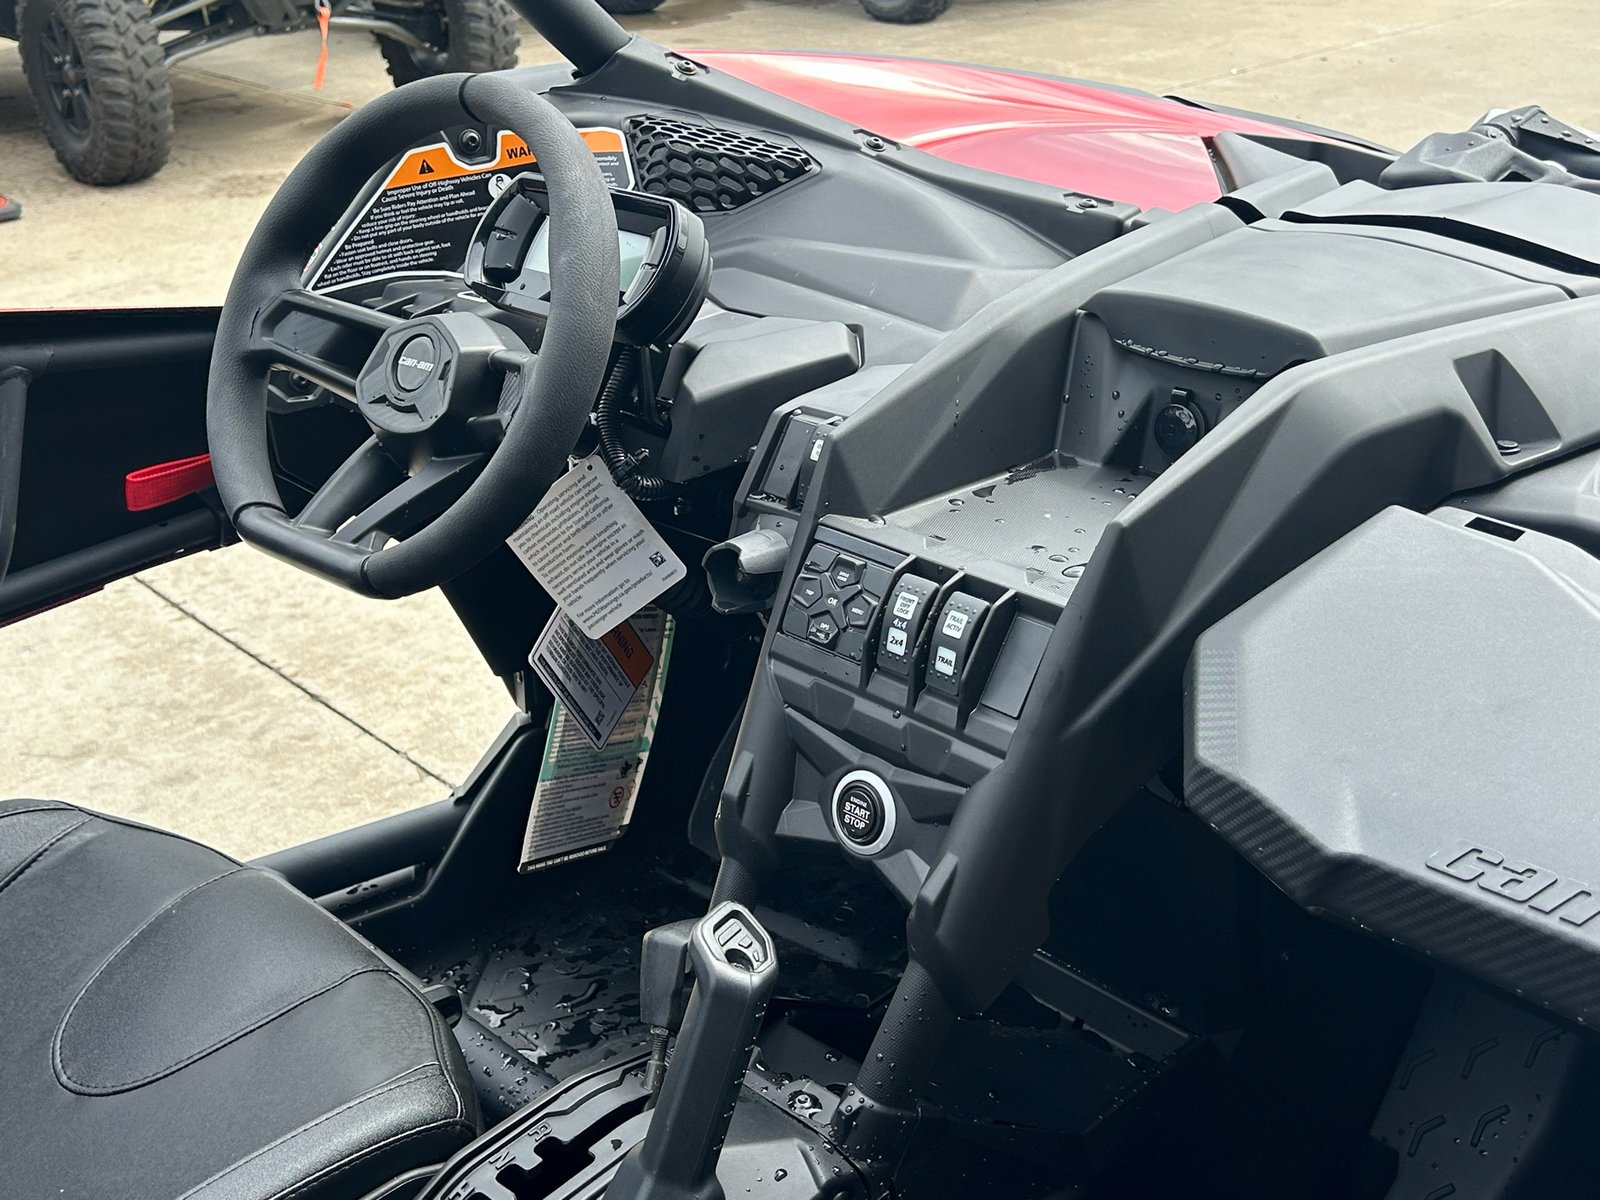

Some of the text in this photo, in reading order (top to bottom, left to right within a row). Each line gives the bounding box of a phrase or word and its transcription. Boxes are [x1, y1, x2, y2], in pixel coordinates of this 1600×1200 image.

[352, 239, 374, 248] Prepared
[398, 356, 433, 371] can-am
[827, 597, 839, 606] OK
[900, 596, 915, 604] FRONT
[851, 607, 865, 616] MENU
[896, 607, 909, 615] LOCK
[893, 618, 908, 630] 4x4
[949, 615, 964, 625] TRAIL
[819, 622, 830, 631] DPS
[945, 623, 962, 632] ACTIV
[890, 636, 904, 647] 2x4
[938, 655, 953, 667] TRAIL
[850, 796, 868, 808] ENGINE
[844, 801, 871, 820] START
[843, 814, 866, 830] STOP
[528, 1122, 553, 1142] R
[488, 1150, 516, 1170] N
